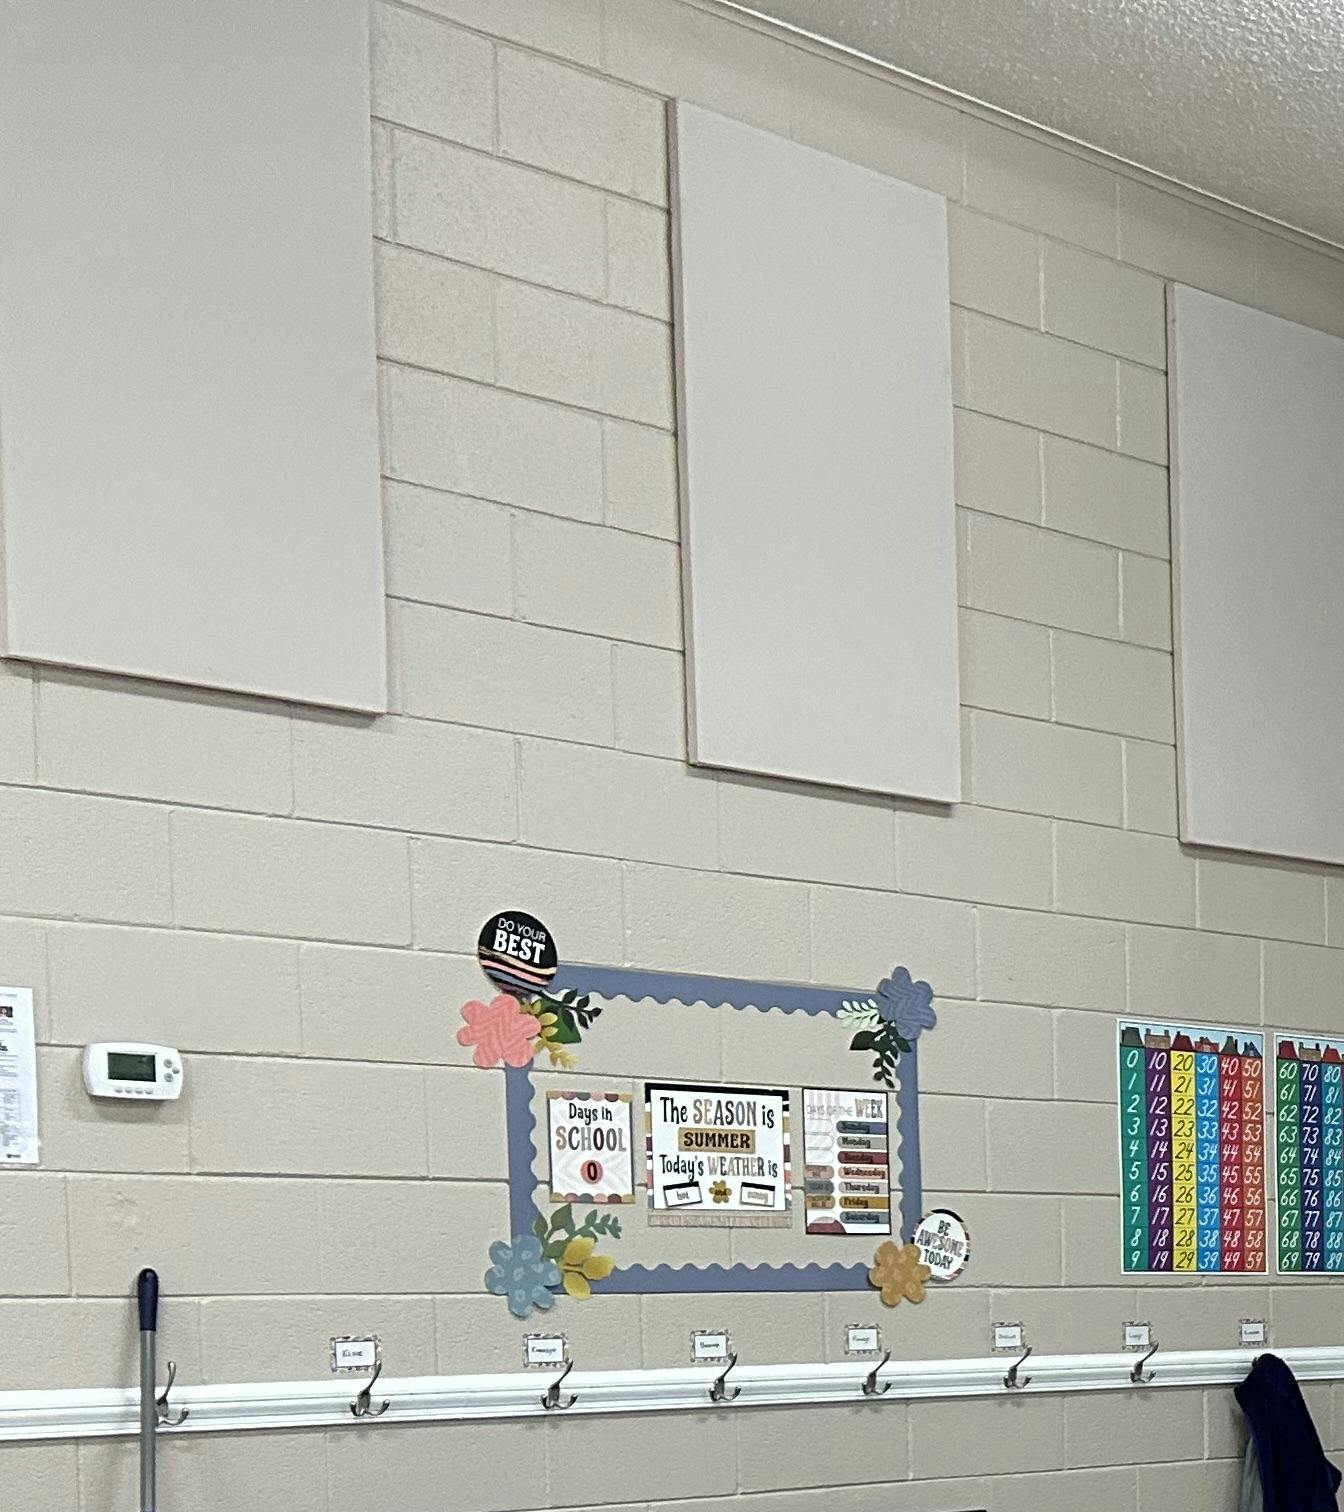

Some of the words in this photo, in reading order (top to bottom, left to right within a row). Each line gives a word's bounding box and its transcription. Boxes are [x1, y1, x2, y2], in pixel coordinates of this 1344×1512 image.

[498, 918, 515, 931] DO
[517, 922, 546, 942] YOUR
[493, 929, 545, 963] BEST
[1126, 1051, 1138, 1067] 0
[1150, 1052, 1167, 1069] 10
[1174, 1054, 1194, 1072] 20
[1197, 1056, 1217, 1073] 30
[1221, 1057, 1239, 1075] 40
[1244, 1058, 1261, 1077] 50
[1280, 1061, 1297, 1079] 60
[1303, 1063, 1319, 1081] 70
[1324, 1065, 1341, 1082] 80
[569, 1103, 598, 1125] Days
[601, 1106, 613, 1121] in
[660, 1097, 688, 1124] The
[693, 1099, 757, 1126] SEASON
[762, 1105, 774, 1128] is
[855, 1099, 884, 1118] WEEK
[556, 1126, 626, 1152] SCHOOL
[684, 1132, 750, 1148] SUMMER
[587, 1162, 597, 1180] 0
[659, 1154, 704, 1181] Today's
[707, 1156, 765, 1177] WEATHER
[768, 1160, 778, 1178] is
[843, 1167, 886, 1179] Wednesday
[845, 1182, 880, 1194] Thursday
[938, 1220, 950, 1236] BE
[916, 1230, 964, 1257] AWESOME
[924, 1250, 953, 1269] TODAY
